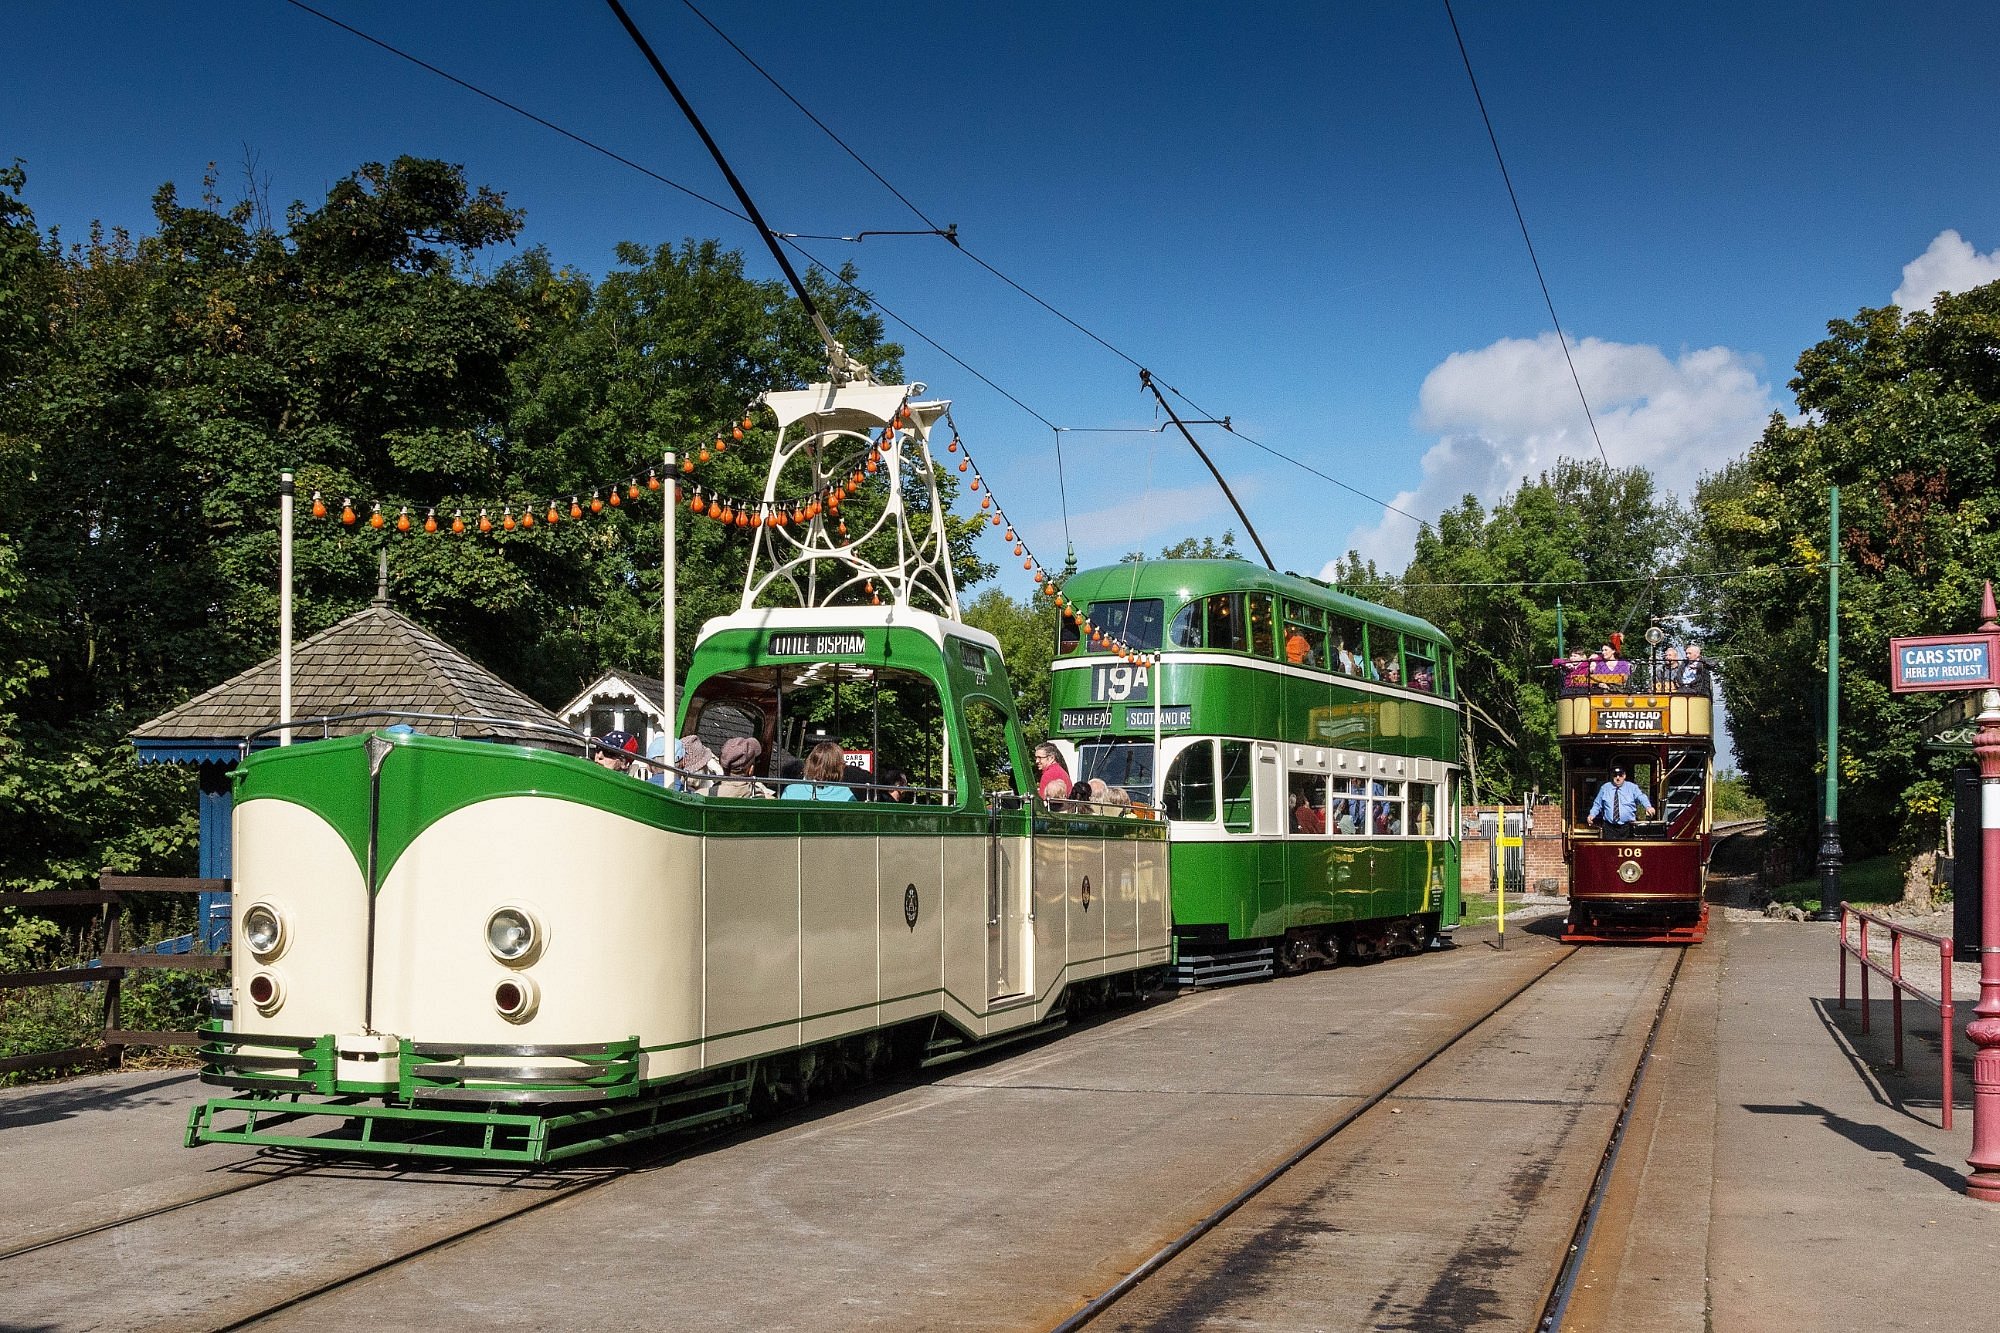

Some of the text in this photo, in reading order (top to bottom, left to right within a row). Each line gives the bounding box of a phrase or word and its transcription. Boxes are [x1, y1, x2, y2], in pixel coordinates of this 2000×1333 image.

[816, 635, 866, 654] BISPHAM
[1905, 648, 1982, 665] CARS STOP
[1905, 664, 1982, 679] HERE BY REQUEST
[1062, 712, 1112, 726] PIER HEAD
[1130, 712, 1178, 725] SCOTAND
[1599, 711, 1661, 720] PLUMSTEAD
[1605, 719, 1654, 730] STATION
[1617, 847, 1642, 858] 106
